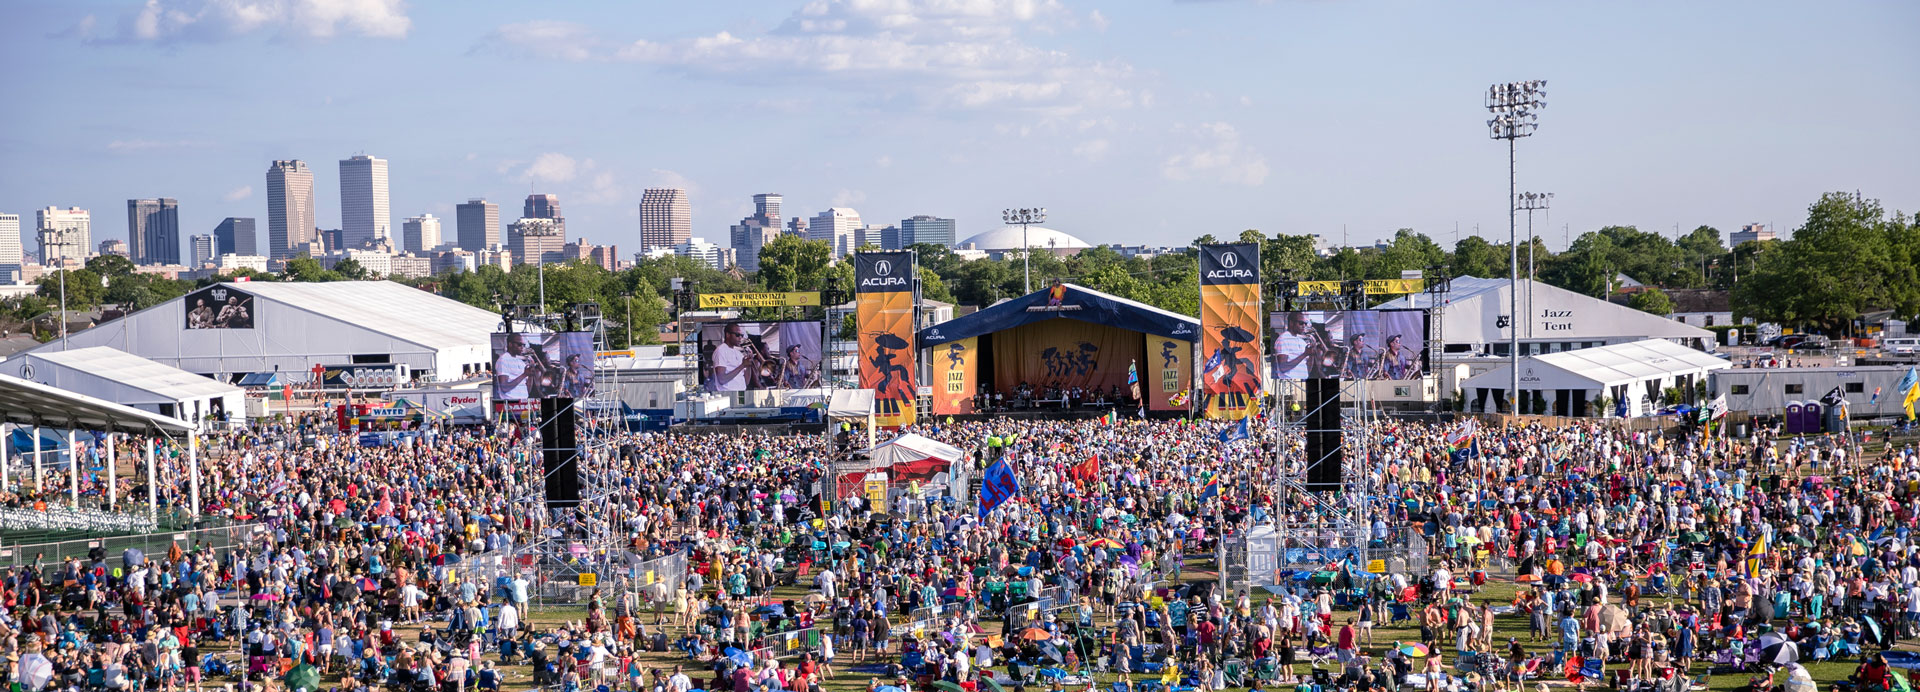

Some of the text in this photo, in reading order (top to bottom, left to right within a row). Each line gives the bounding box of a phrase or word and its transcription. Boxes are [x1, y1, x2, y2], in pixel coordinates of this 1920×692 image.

[1207, 269, 1253, 278] ACURA
[861, 277, 907, 287] ACURA
[1541, 309, 1573, 318] Jazz
[1541, 321, 1572, 331] Tent
[948, 372, 964, 381] JAZZ
[1163, 370, 1178, 380] JAZZ
[948, 382, 963, 391] FEST
[1163, 381, 1178, 391] FEST
[451, 396, 477, 405] Ryder
